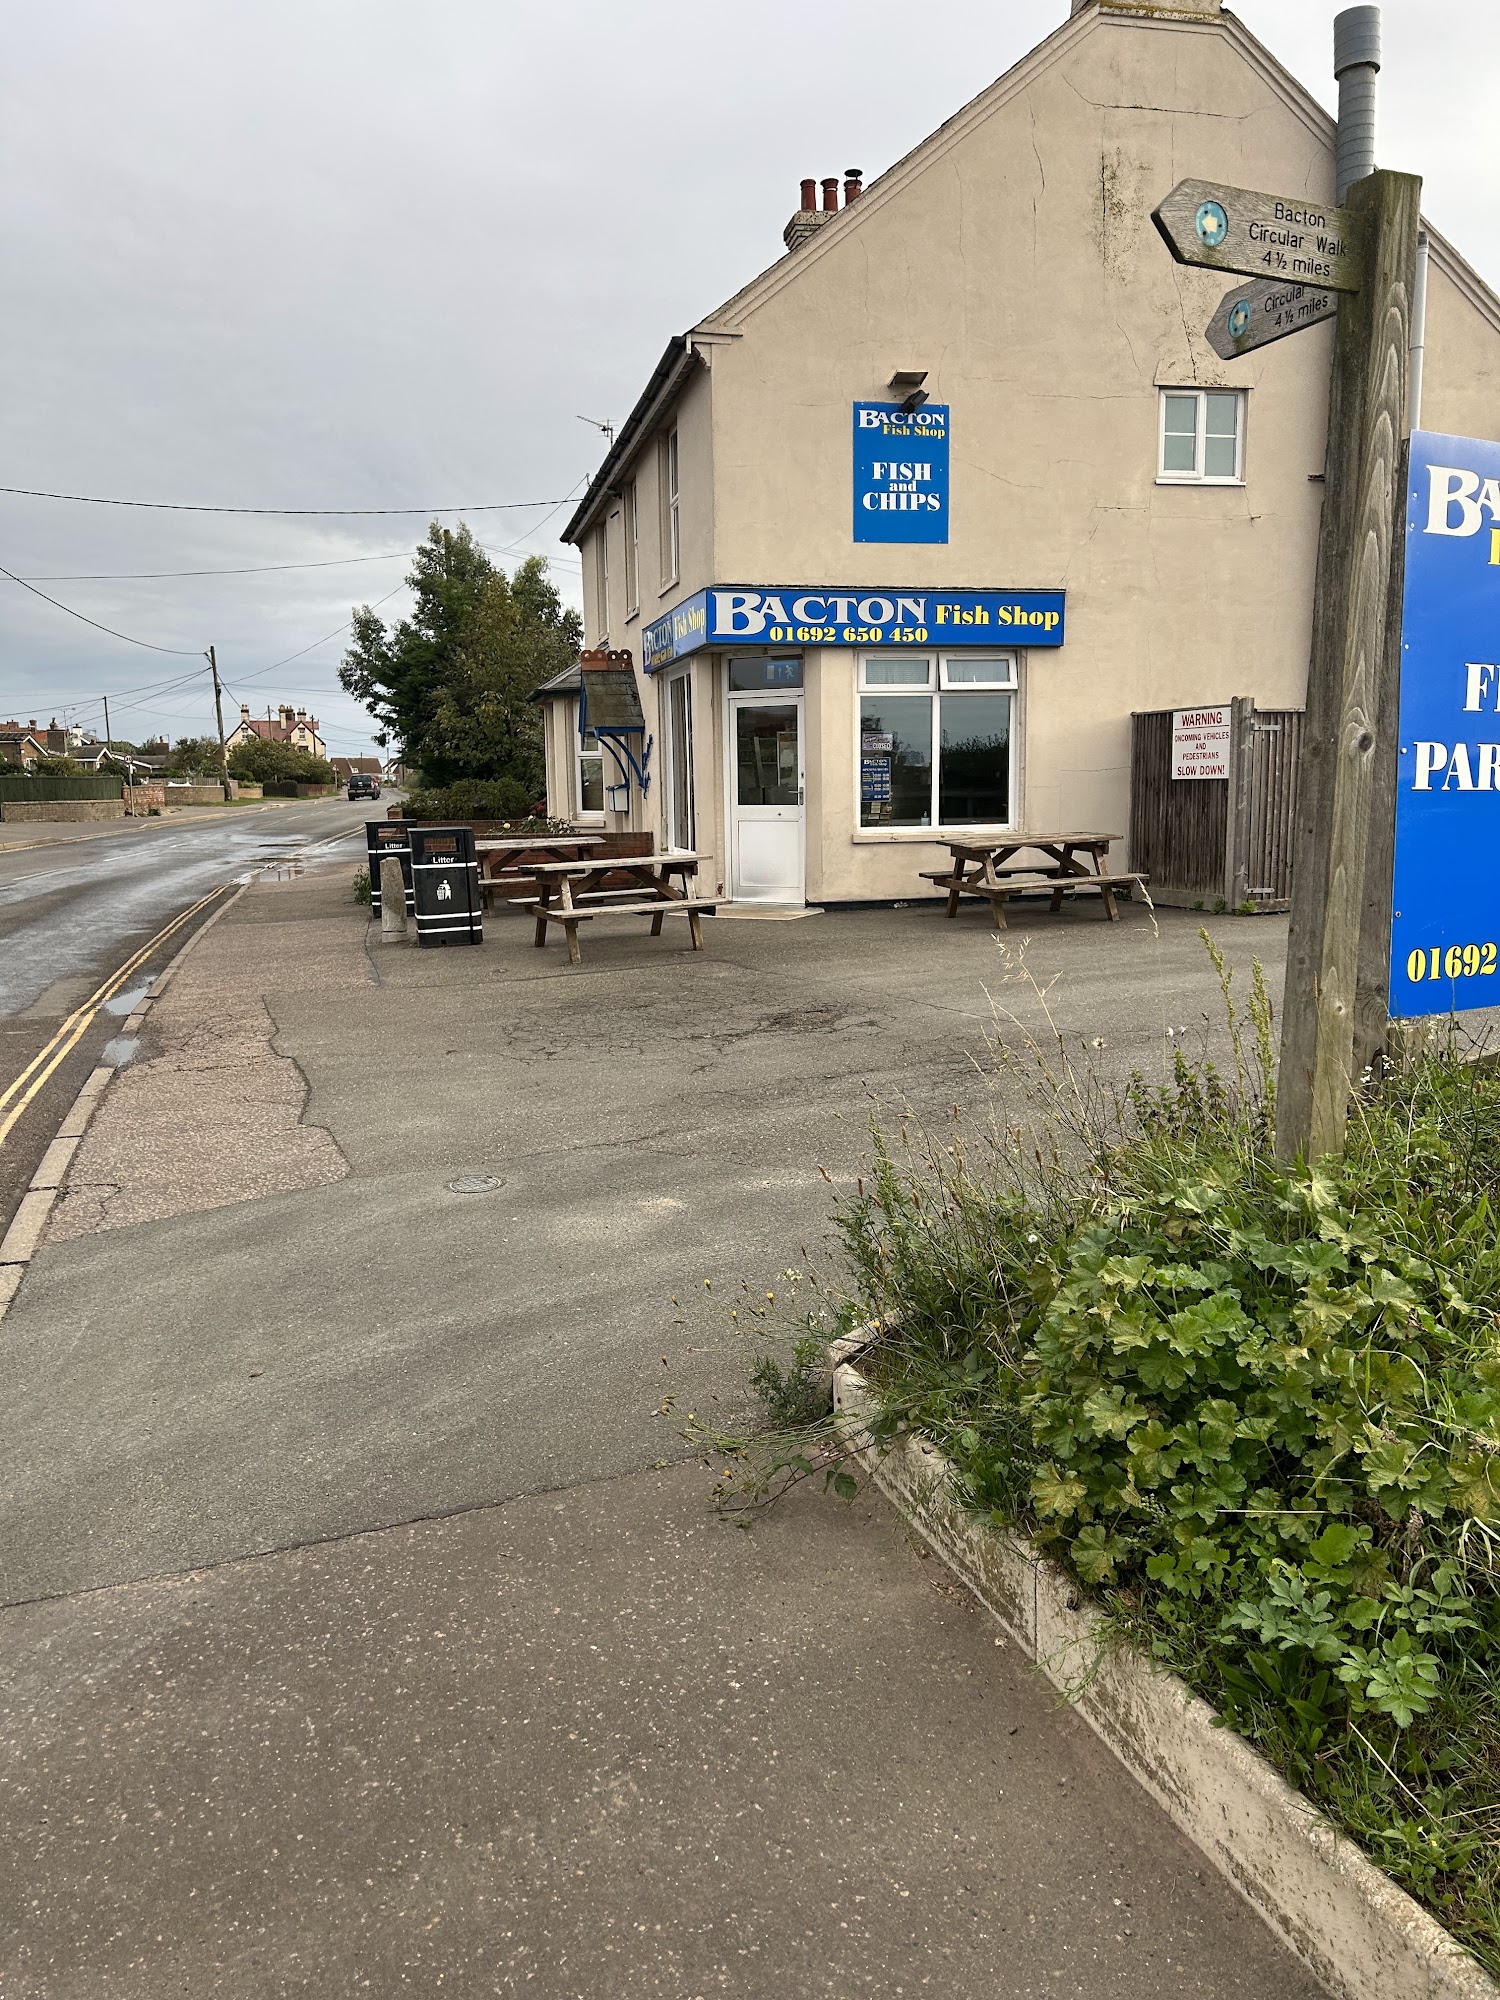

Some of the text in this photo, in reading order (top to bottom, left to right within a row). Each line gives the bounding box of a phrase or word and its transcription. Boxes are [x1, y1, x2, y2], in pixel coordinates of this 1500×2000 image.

[1275, 202, 1326, 229] Bacton
[1249, 222, 1305, 249] Circular
[1316, 234, 1347, 257] Walk
[1293, 257, 1331, 277] miles
[1298, 295, 1328, 319] miles
[858, 409, 945, 428] BACTON
[883, 424, 946, 440] Fish Shop
[872, 462, 932, 481] FISH
[889, 481, 917, 492] and
[862, 492, 941, 511] CHIPS
[673, 611, 687, 641] Fish
[688, 605, 705, 635] Shop
[711, 592, 1060, 635] BACTON Fish Shop
[769, 626, 929, 642] 01692 650 450
[1181, 711, 1223, 727] WARNING
[1174, 731, 1230, 743] ONCOMING VEHICLES
[1195, 742, 1207, 750] AND
[1182, 751, 1220, 761] PEDESTRIANS
[1177, 764, 1225, 776] SLOW DOWN!
[432, 856, 455, 864] Litter
[1406, 942, 1498, 983] 01692
